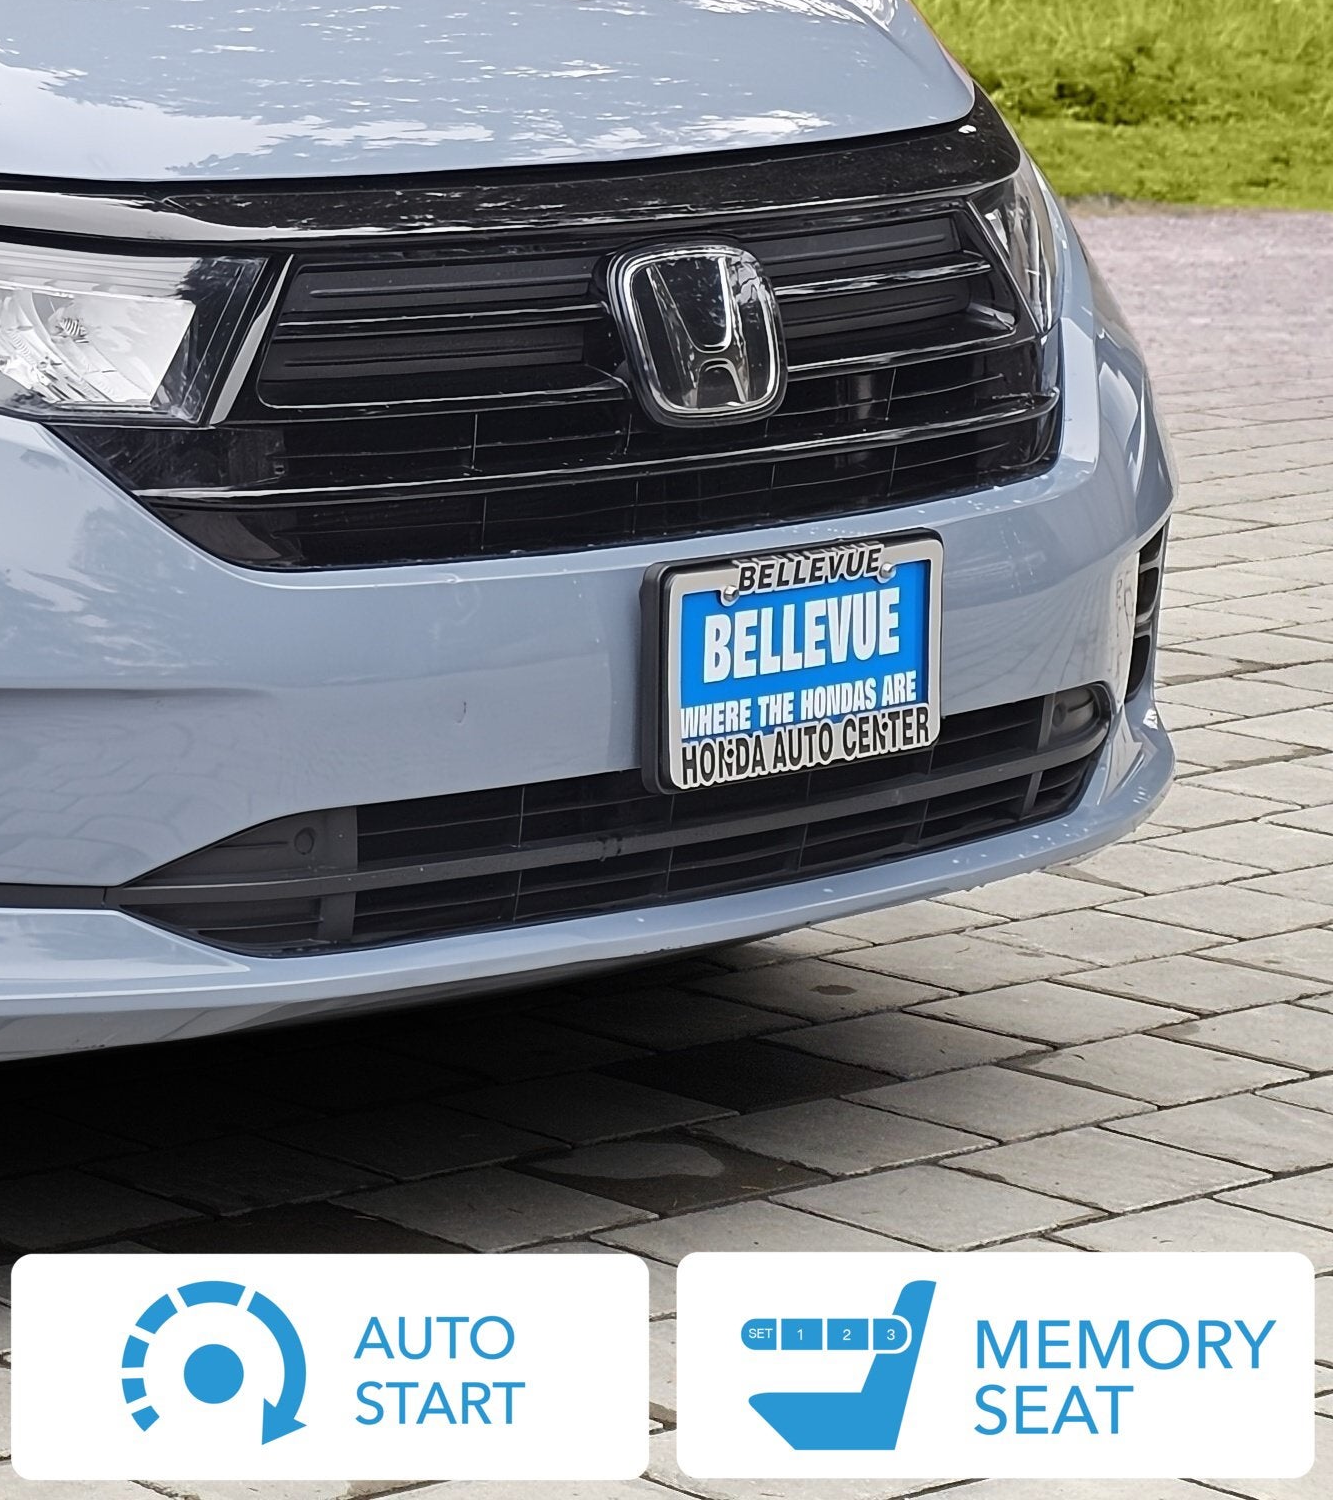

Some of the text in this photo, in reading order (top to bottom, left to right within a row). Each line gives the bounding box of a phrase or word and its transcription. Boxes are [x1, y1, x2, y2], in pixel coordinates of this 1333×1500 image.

[738, 547, 883, 592] BELLEVUE
[703, 587, 900, 684] BELLEVUE
[681, 670, 917, 739] WHERE THE HONDAS ARE
[682, 706, 930, 786] HONDA AUTO CENTER
